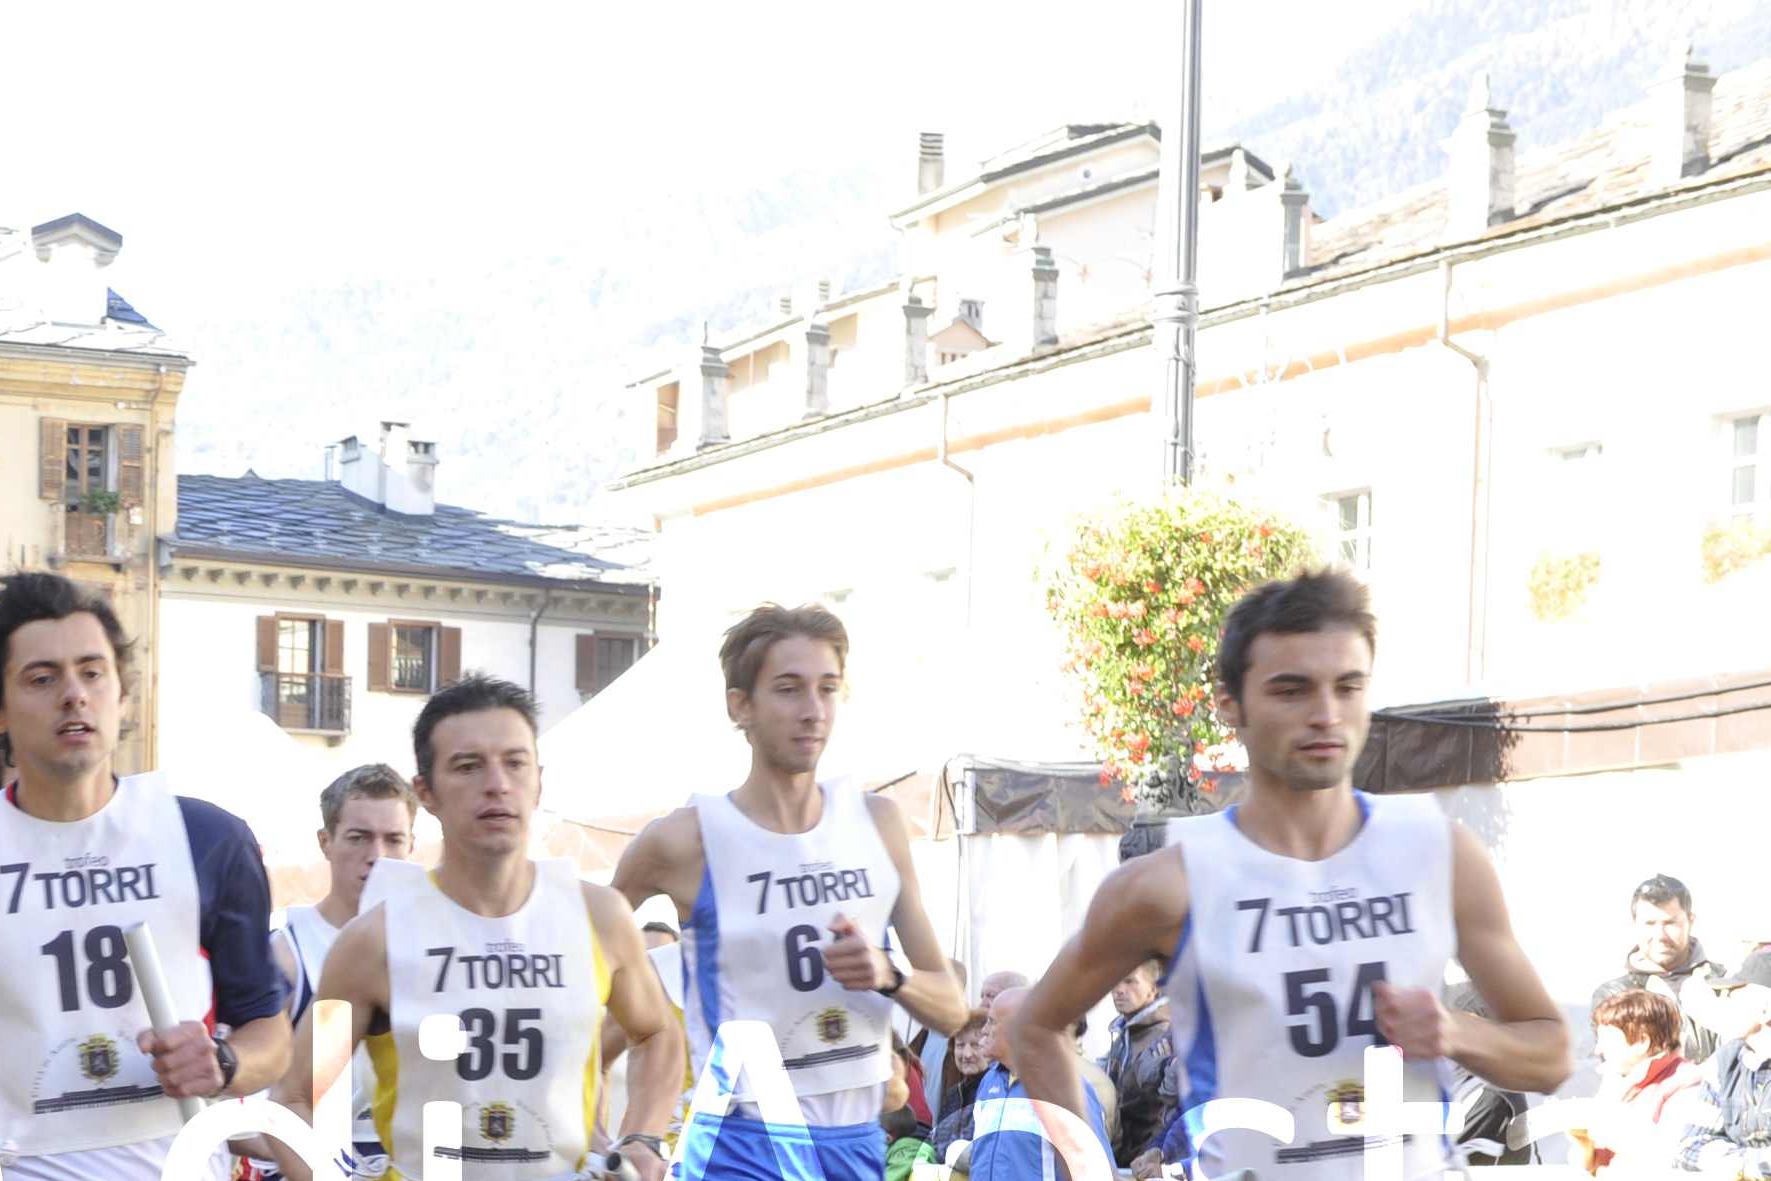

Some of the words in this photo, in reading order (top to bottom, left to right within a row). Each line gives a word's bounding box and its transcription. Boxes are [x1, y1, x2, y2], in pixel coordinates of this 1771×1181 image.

[0, 862, 31, 914] 7
[33, 863, 160, 910] TORRI
[746, 871, 773, 915] 7
[775, 868, 876, 909] TORRI
[1236, 898, 1272, 953] 7
[1275, 892, 1416, 947] TORRI
[41, 925, 133, 1012] 18
[425, 947, 455, 993] 7
[457, 954, 567, 990] TORRI
[1281, 961, 1390, 1058] 54
[456, 1007, 544, 1081] 35
